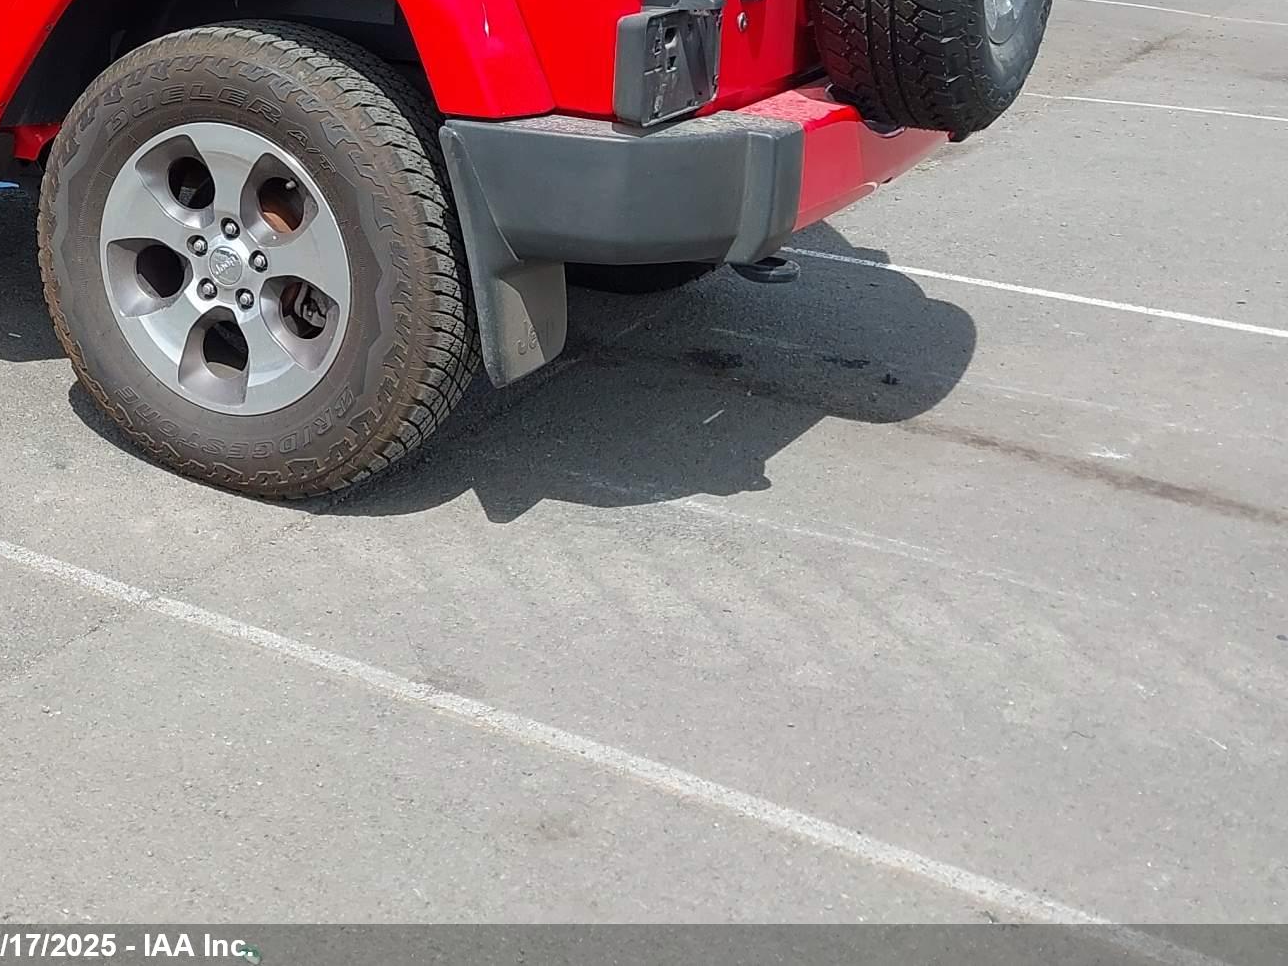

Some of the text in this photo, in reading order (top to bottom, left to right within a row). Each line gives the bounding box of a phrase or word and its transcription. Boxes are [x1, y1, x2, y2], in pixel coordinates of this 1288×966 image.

[103, 82, 338, 175] DUELER A/T
[114, 384, 357, 460] BRIDGESTONE
